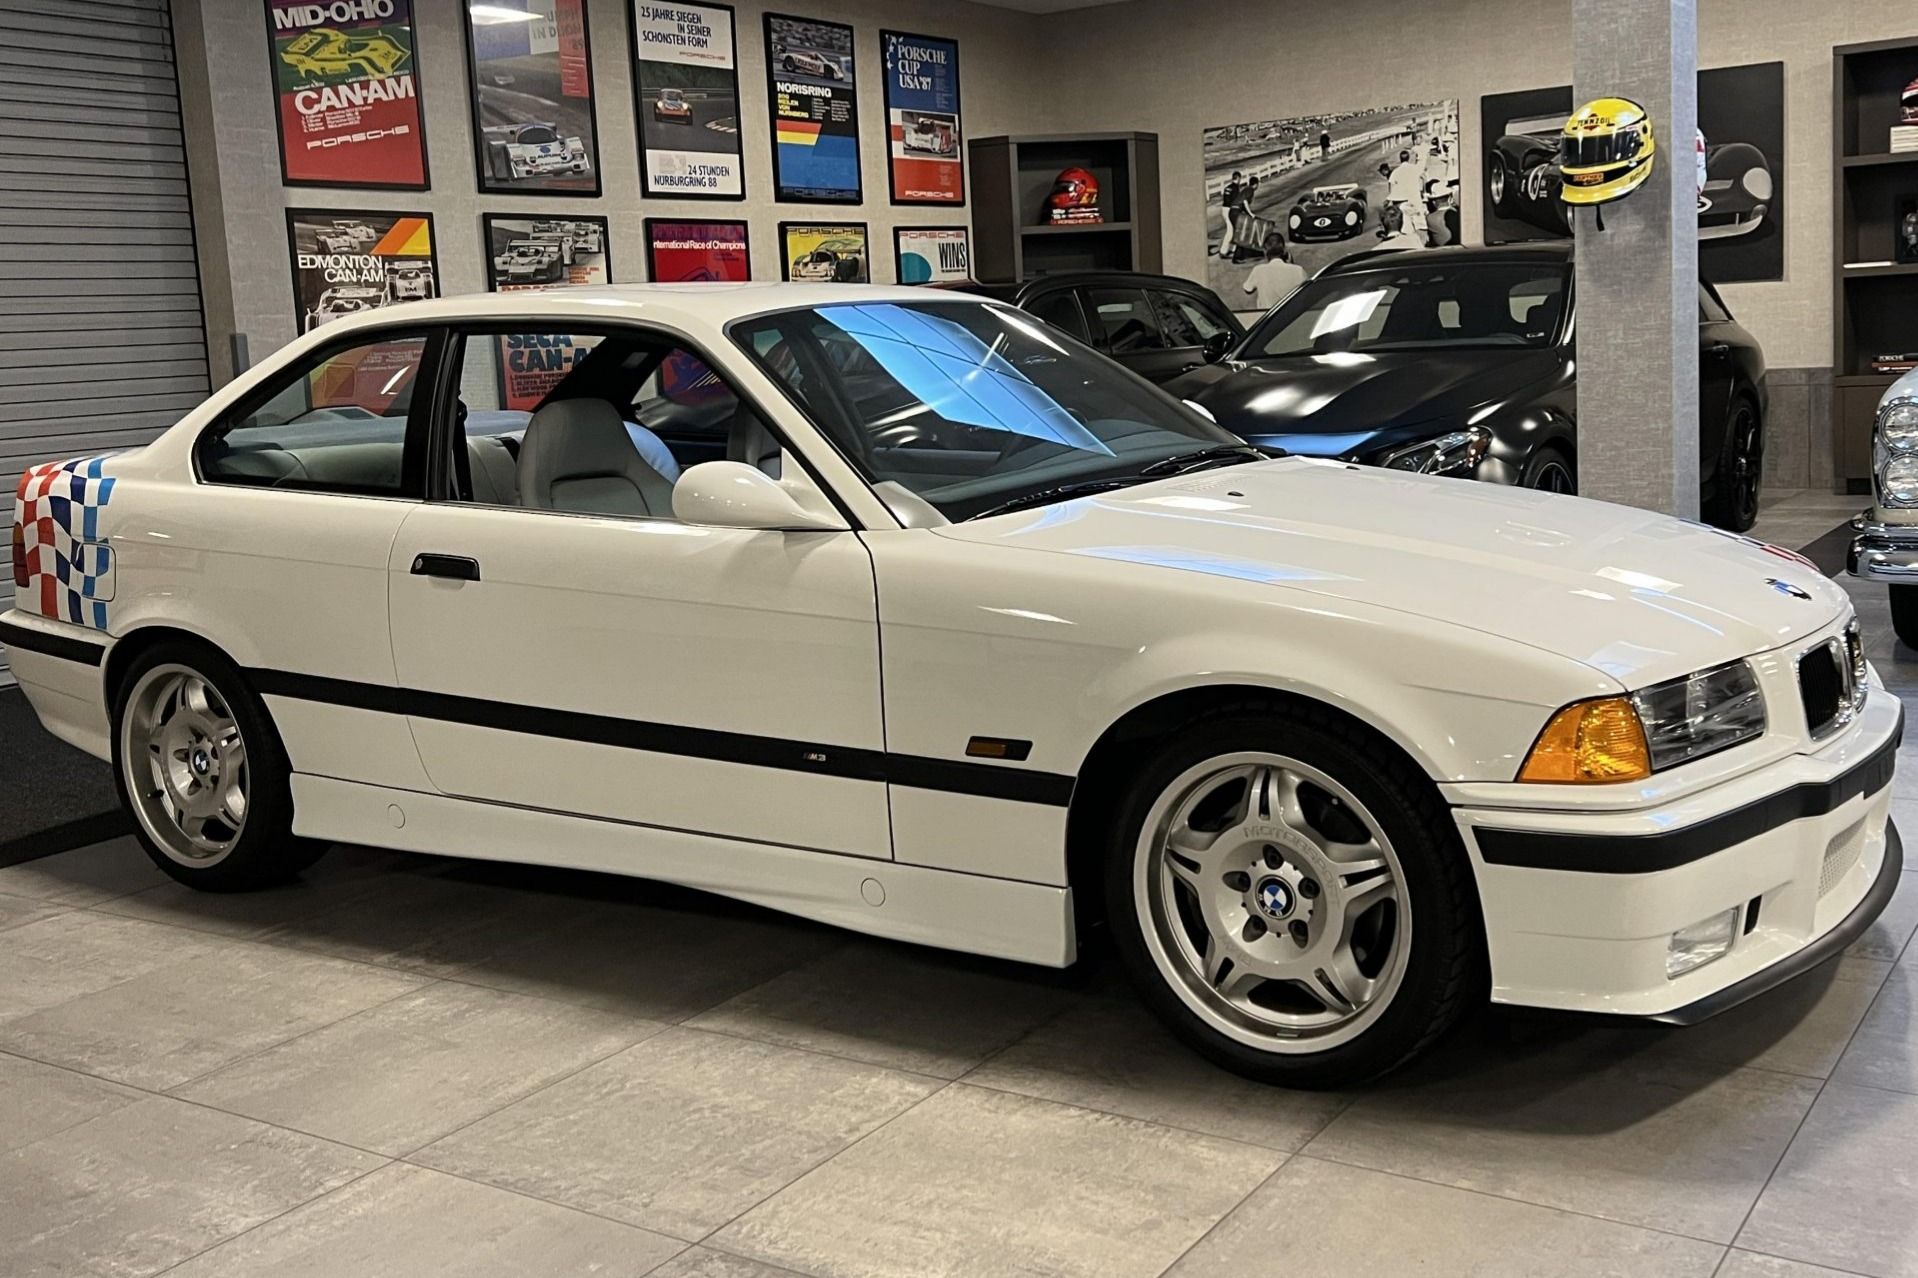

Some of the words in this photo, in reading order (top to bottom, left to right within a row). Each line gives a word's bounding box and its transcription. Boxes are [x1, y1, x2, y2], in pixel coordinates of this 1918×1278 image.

[641, 6, 651, 18] 25
[652, 8, 675, 21] JAHRE
[676, 11, 702, 25] SIEGEN
[677, 22, 686, 34] IN
[687, 24, 712, 38] SEINER
[687, 35, 709, 49] FORM
[897, 44, 947, 65] PORSCHE
[898, 60, 921, 75] CUP
[776, 81, 832, 98] NORISRING
[306, 124, 410, 150] PORSCHE
[688, 164, 697, 175] 24
[698, 165, 730, 177] STUNDEN
[899, 231, 964, 239] PORSCHE
[690, 240, 706, 250] Race
[297, 254, 382, 269] EDMONTON
[938, 242, 966, 269] WINS
